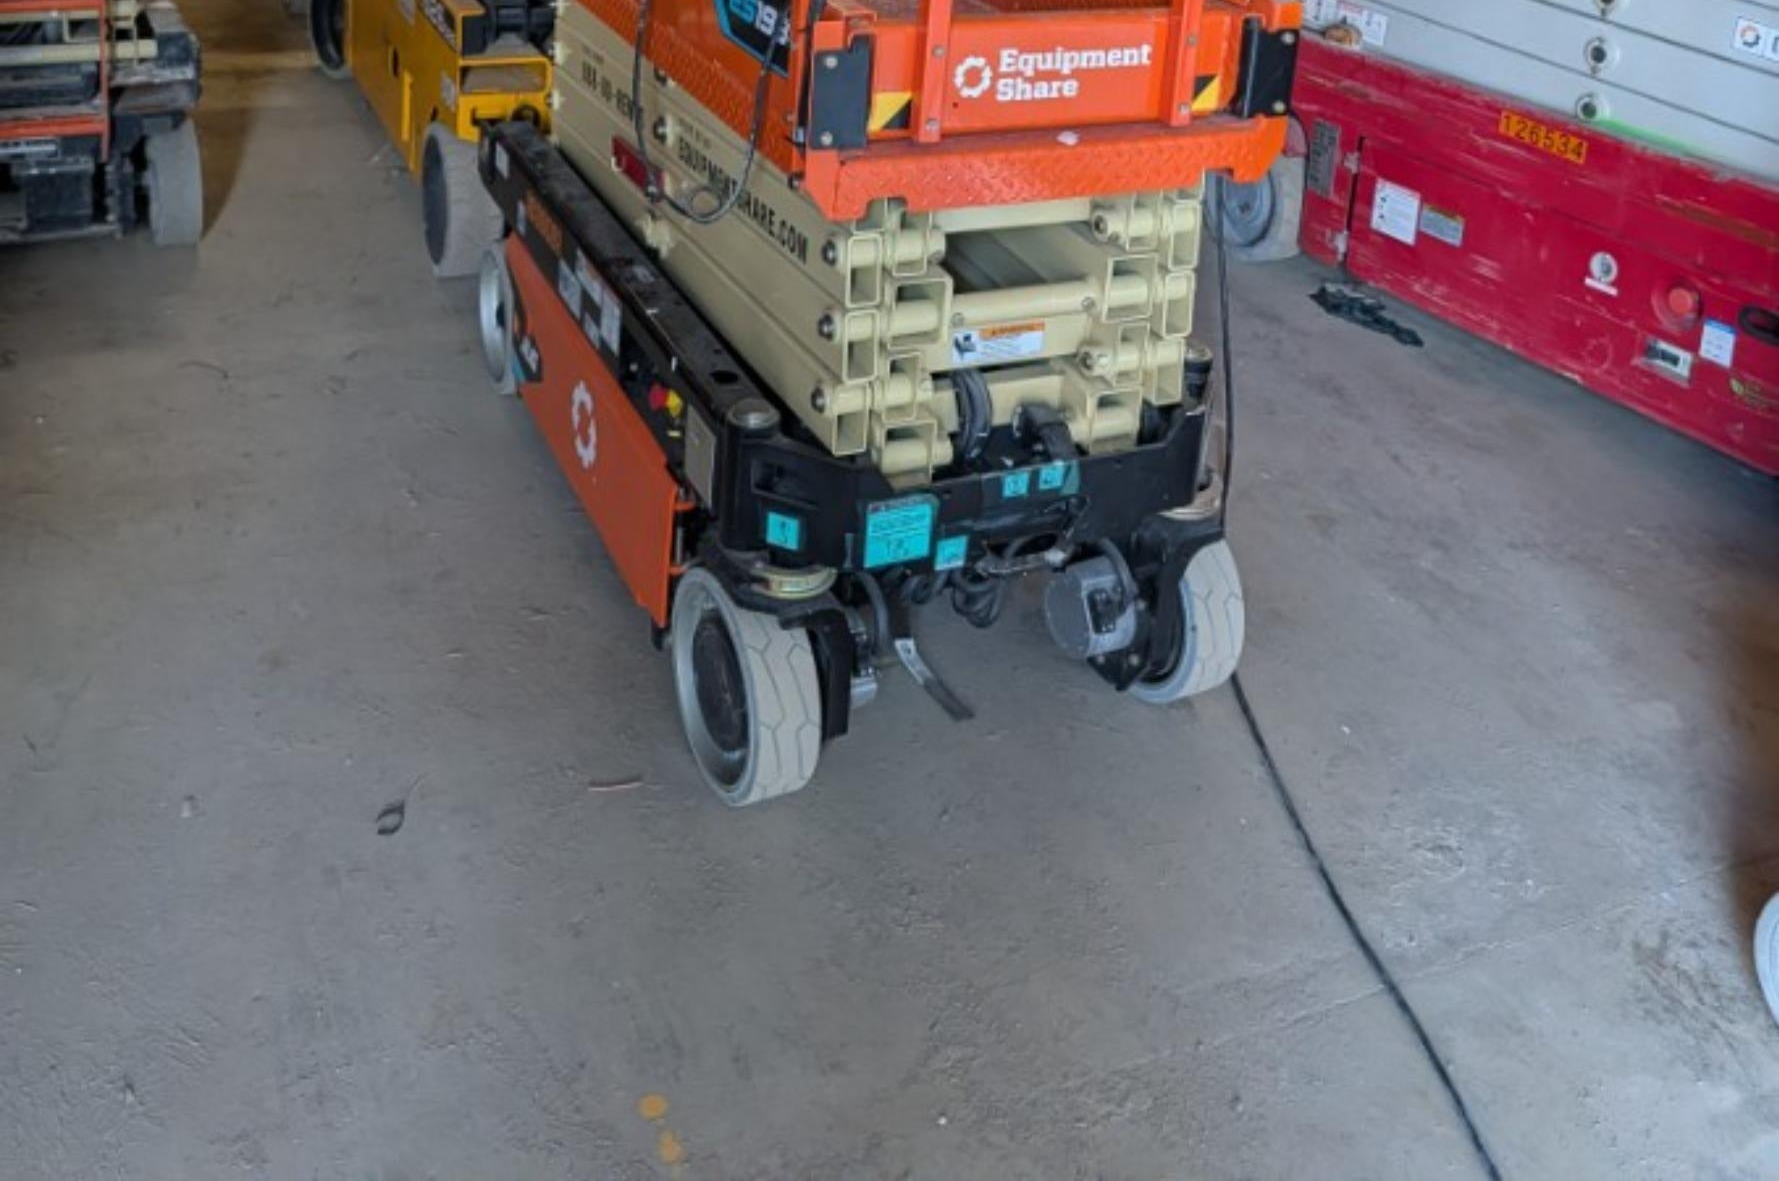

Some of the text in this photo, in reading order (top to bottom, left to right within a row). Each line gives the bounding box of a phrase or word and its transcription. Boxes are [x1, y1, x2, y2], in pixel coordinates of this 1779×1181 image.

[1000, 44, 1152, 77] Equipment
[996, 77, 1079, 101] Share
[1503, 115, 1584, 159] 126534
